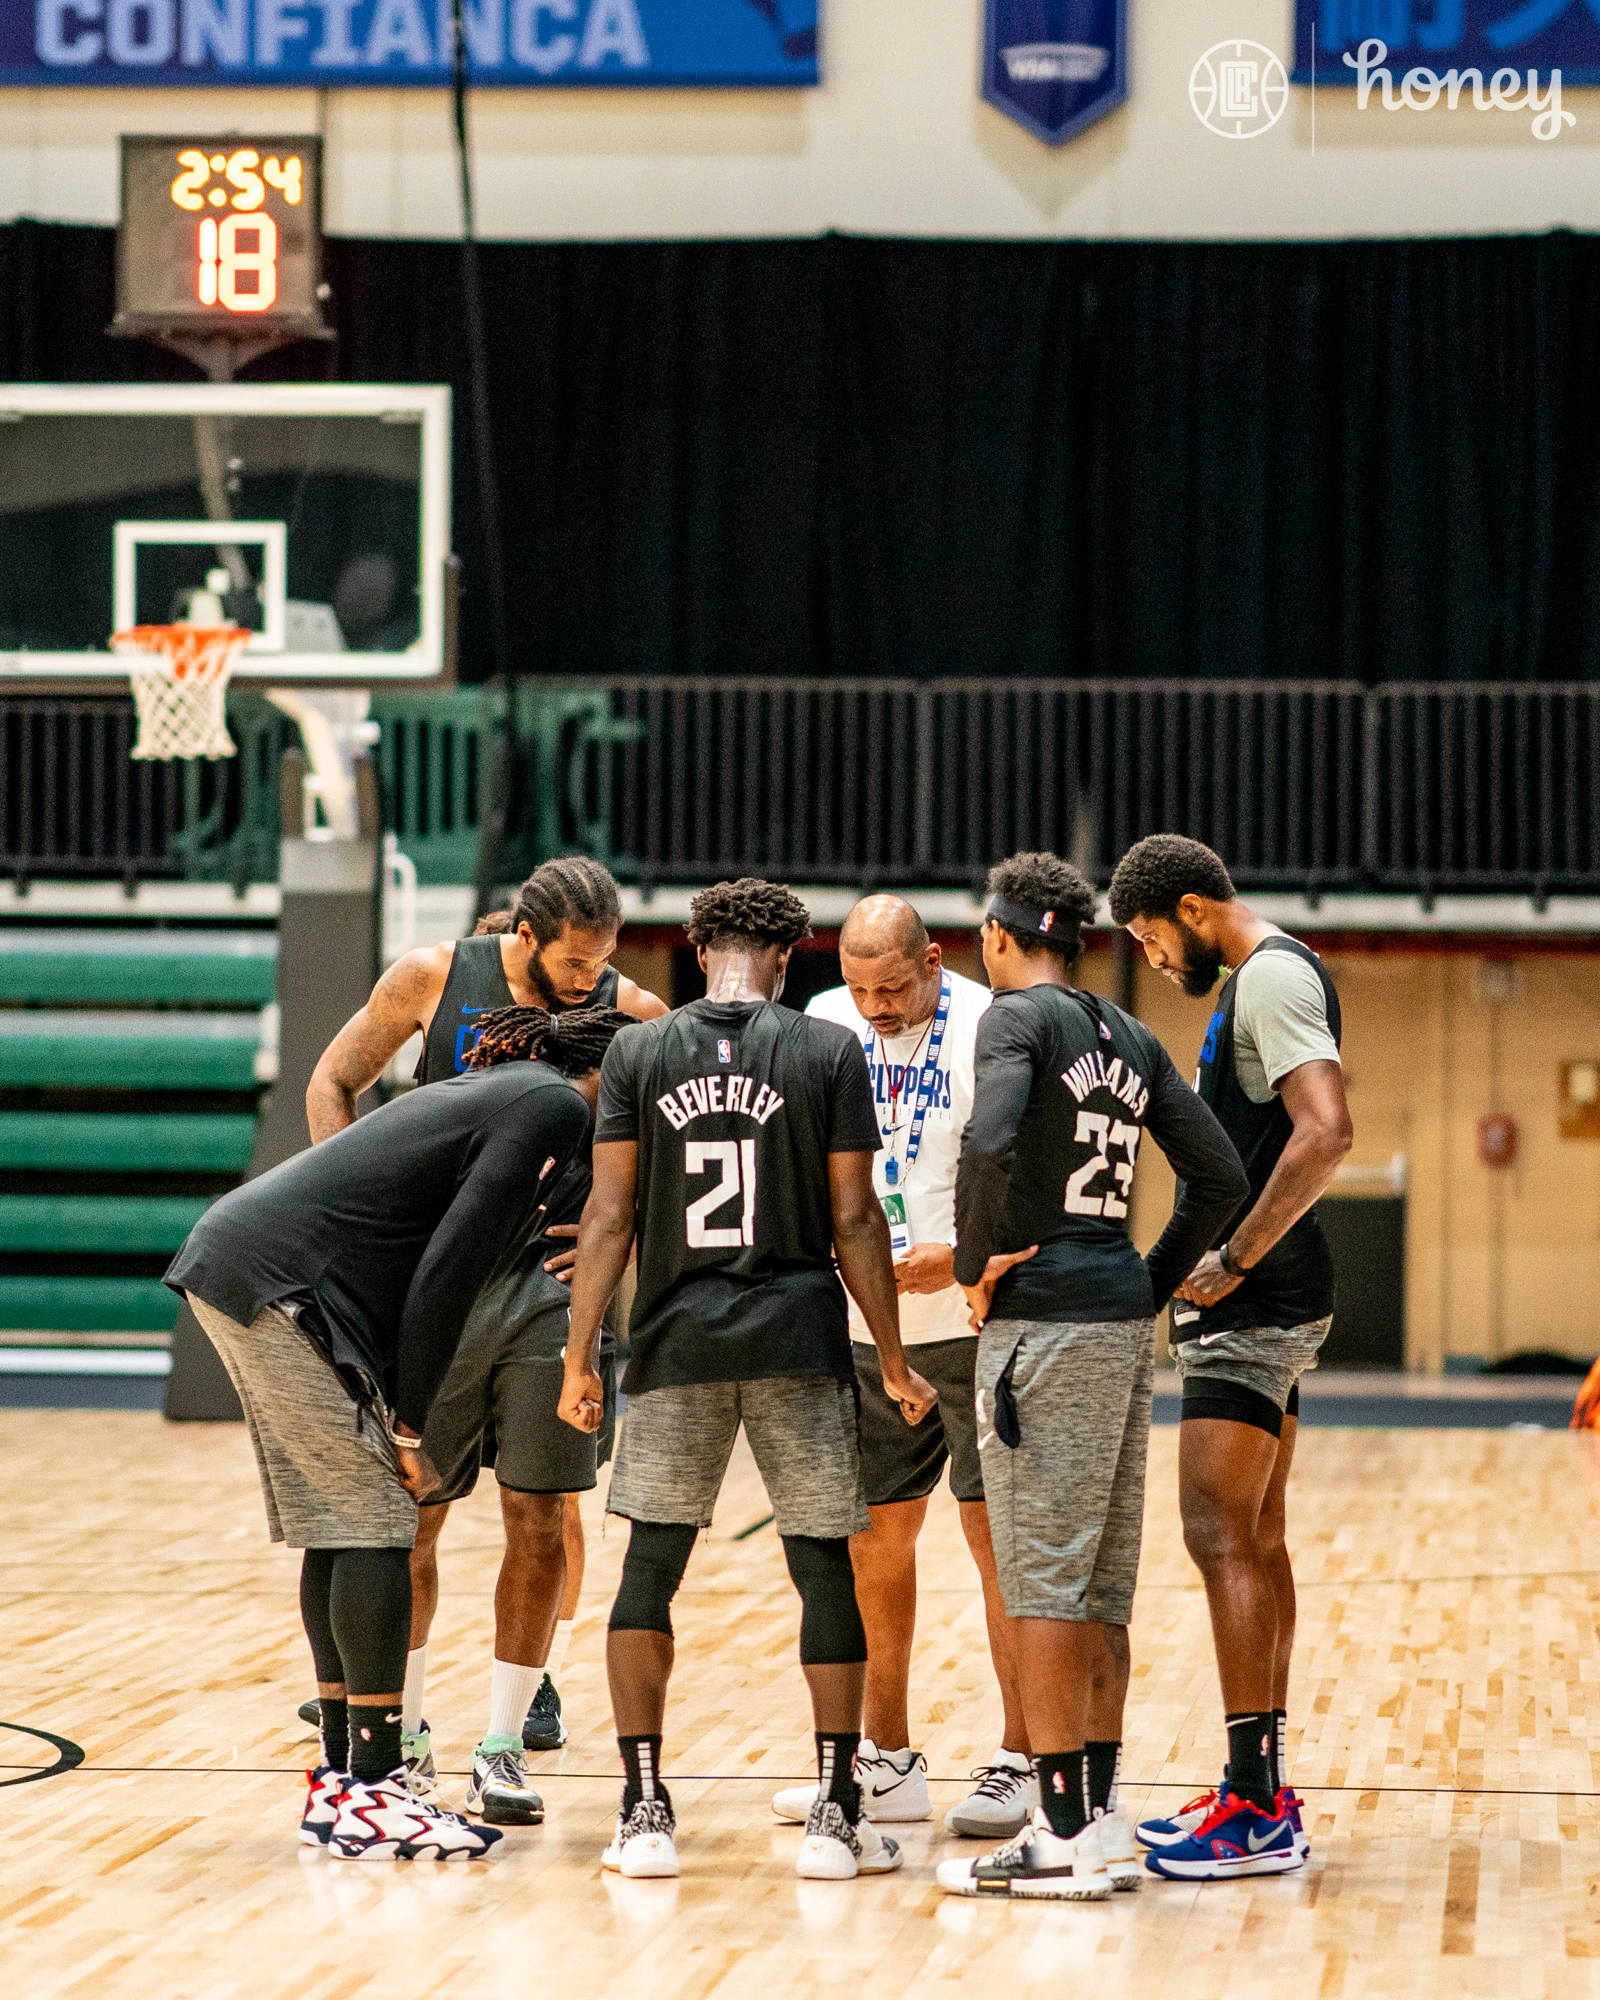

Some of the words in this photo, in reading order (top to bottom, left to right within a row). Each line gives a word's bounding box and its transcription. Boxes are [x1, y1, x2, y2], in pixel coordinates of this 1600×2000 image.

[35, 0, 650, 74] CONFIANÇA
[171, 149, 303, 211] 2:54
[196, 212, 278, 312] 18
[656, 1075, 785, 1131] BEVERLEY
[870, 1063, 951, 1110] CLIPPRS
[1061, 1050, 1149, 1118] WILLAMS
[685, 1139, 756, 1248] 21
[1064, 1111, 1140, 1219] 23
